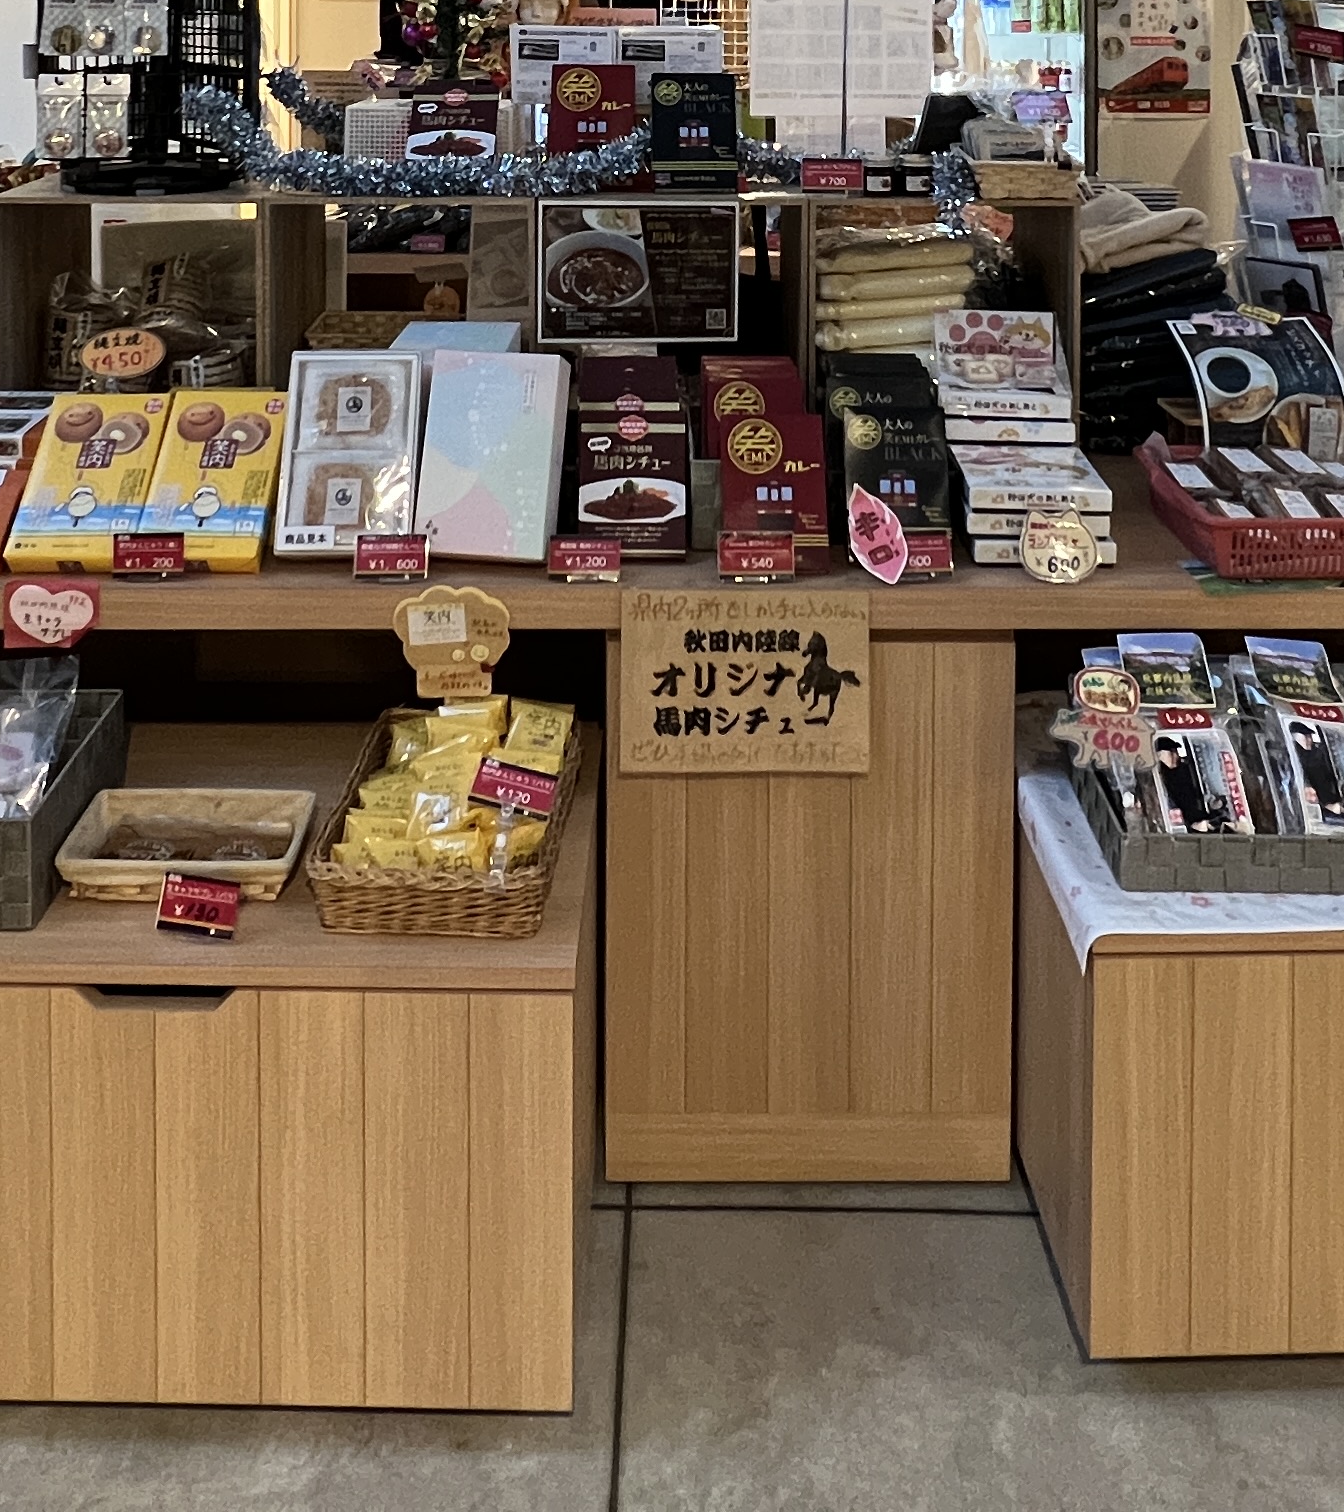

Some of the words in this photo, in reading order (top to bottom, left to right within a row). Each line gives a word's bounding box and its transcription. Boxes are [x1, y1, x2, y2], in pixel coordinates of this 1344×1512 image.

[601, 101, 632, 112] カレー
[819, 177, 847, 186] ¥700
[863, 393, 893, 404] 大人の
[883, 419, 914, 430] 大人の
[743, 451, 769, 465] EMI
[884, 446, 943, 462] BLACK
[593, 454, 672, 471] 馬肉シチュー
[783, 459, 820, 474] カレー
[285, 534, 327, 545] 商品見本
[565, 556, 607, 569] ¥1,200
[740, 557, 774, 570] ¥540
[908, 554, 932, 568] 600
[683, 629, 800, 654] 秋田内陸線
[1165, 712, 1205, 725] しょうゆ
[1300, 704, 1339, 720] しょうゆ
[653, 705, 831, 737] 馬肉シチュー
[1093, 730, 1141, 753] 600
